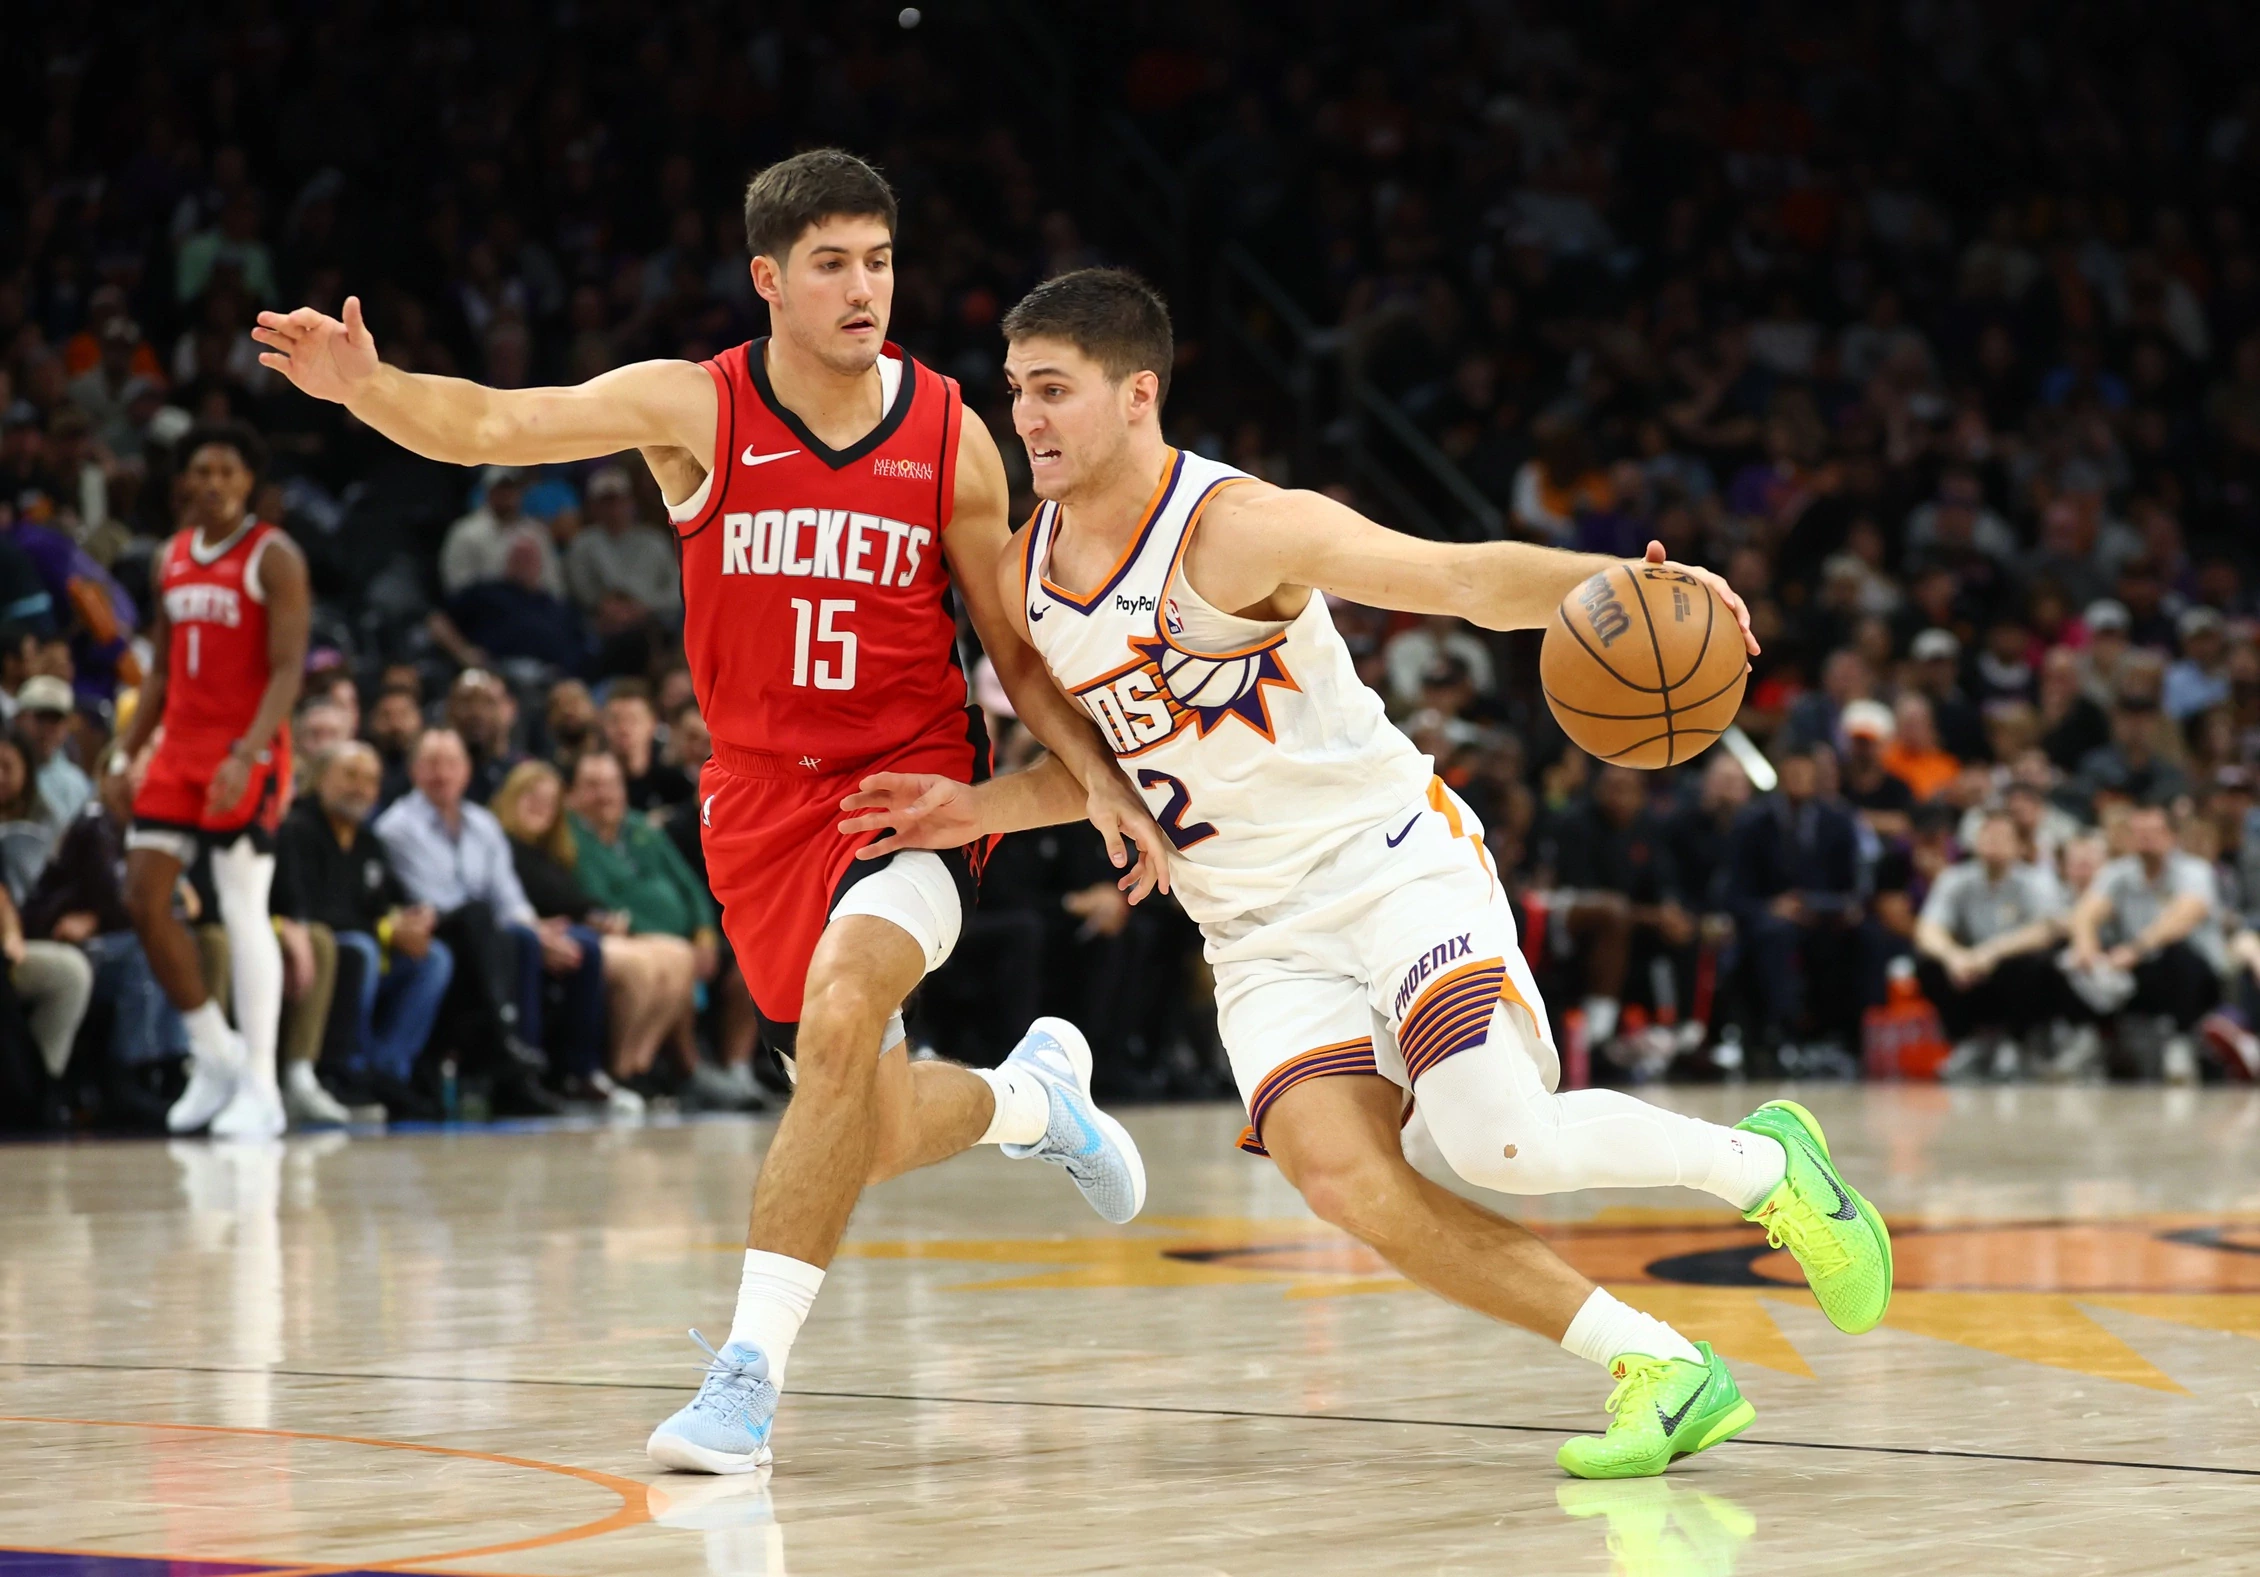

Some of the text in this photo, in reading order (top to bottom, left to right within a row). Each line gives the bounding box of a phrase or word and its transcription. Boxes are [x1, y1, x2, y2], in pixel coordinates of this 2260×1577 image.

[873, 458, 933, 472] MEMORIAL
[873, 465, 934, 480] HERMANN
[721, 507, 932, 588] ROCKETS
[1116, 594, 1156, 616] PayPal
[187, 625, 200, 680] 1
[790, 597, 858, 691] 15
[1077, 668, 1173, 754] NS
[1394, 932, 1473, 1023] PHOENIX
